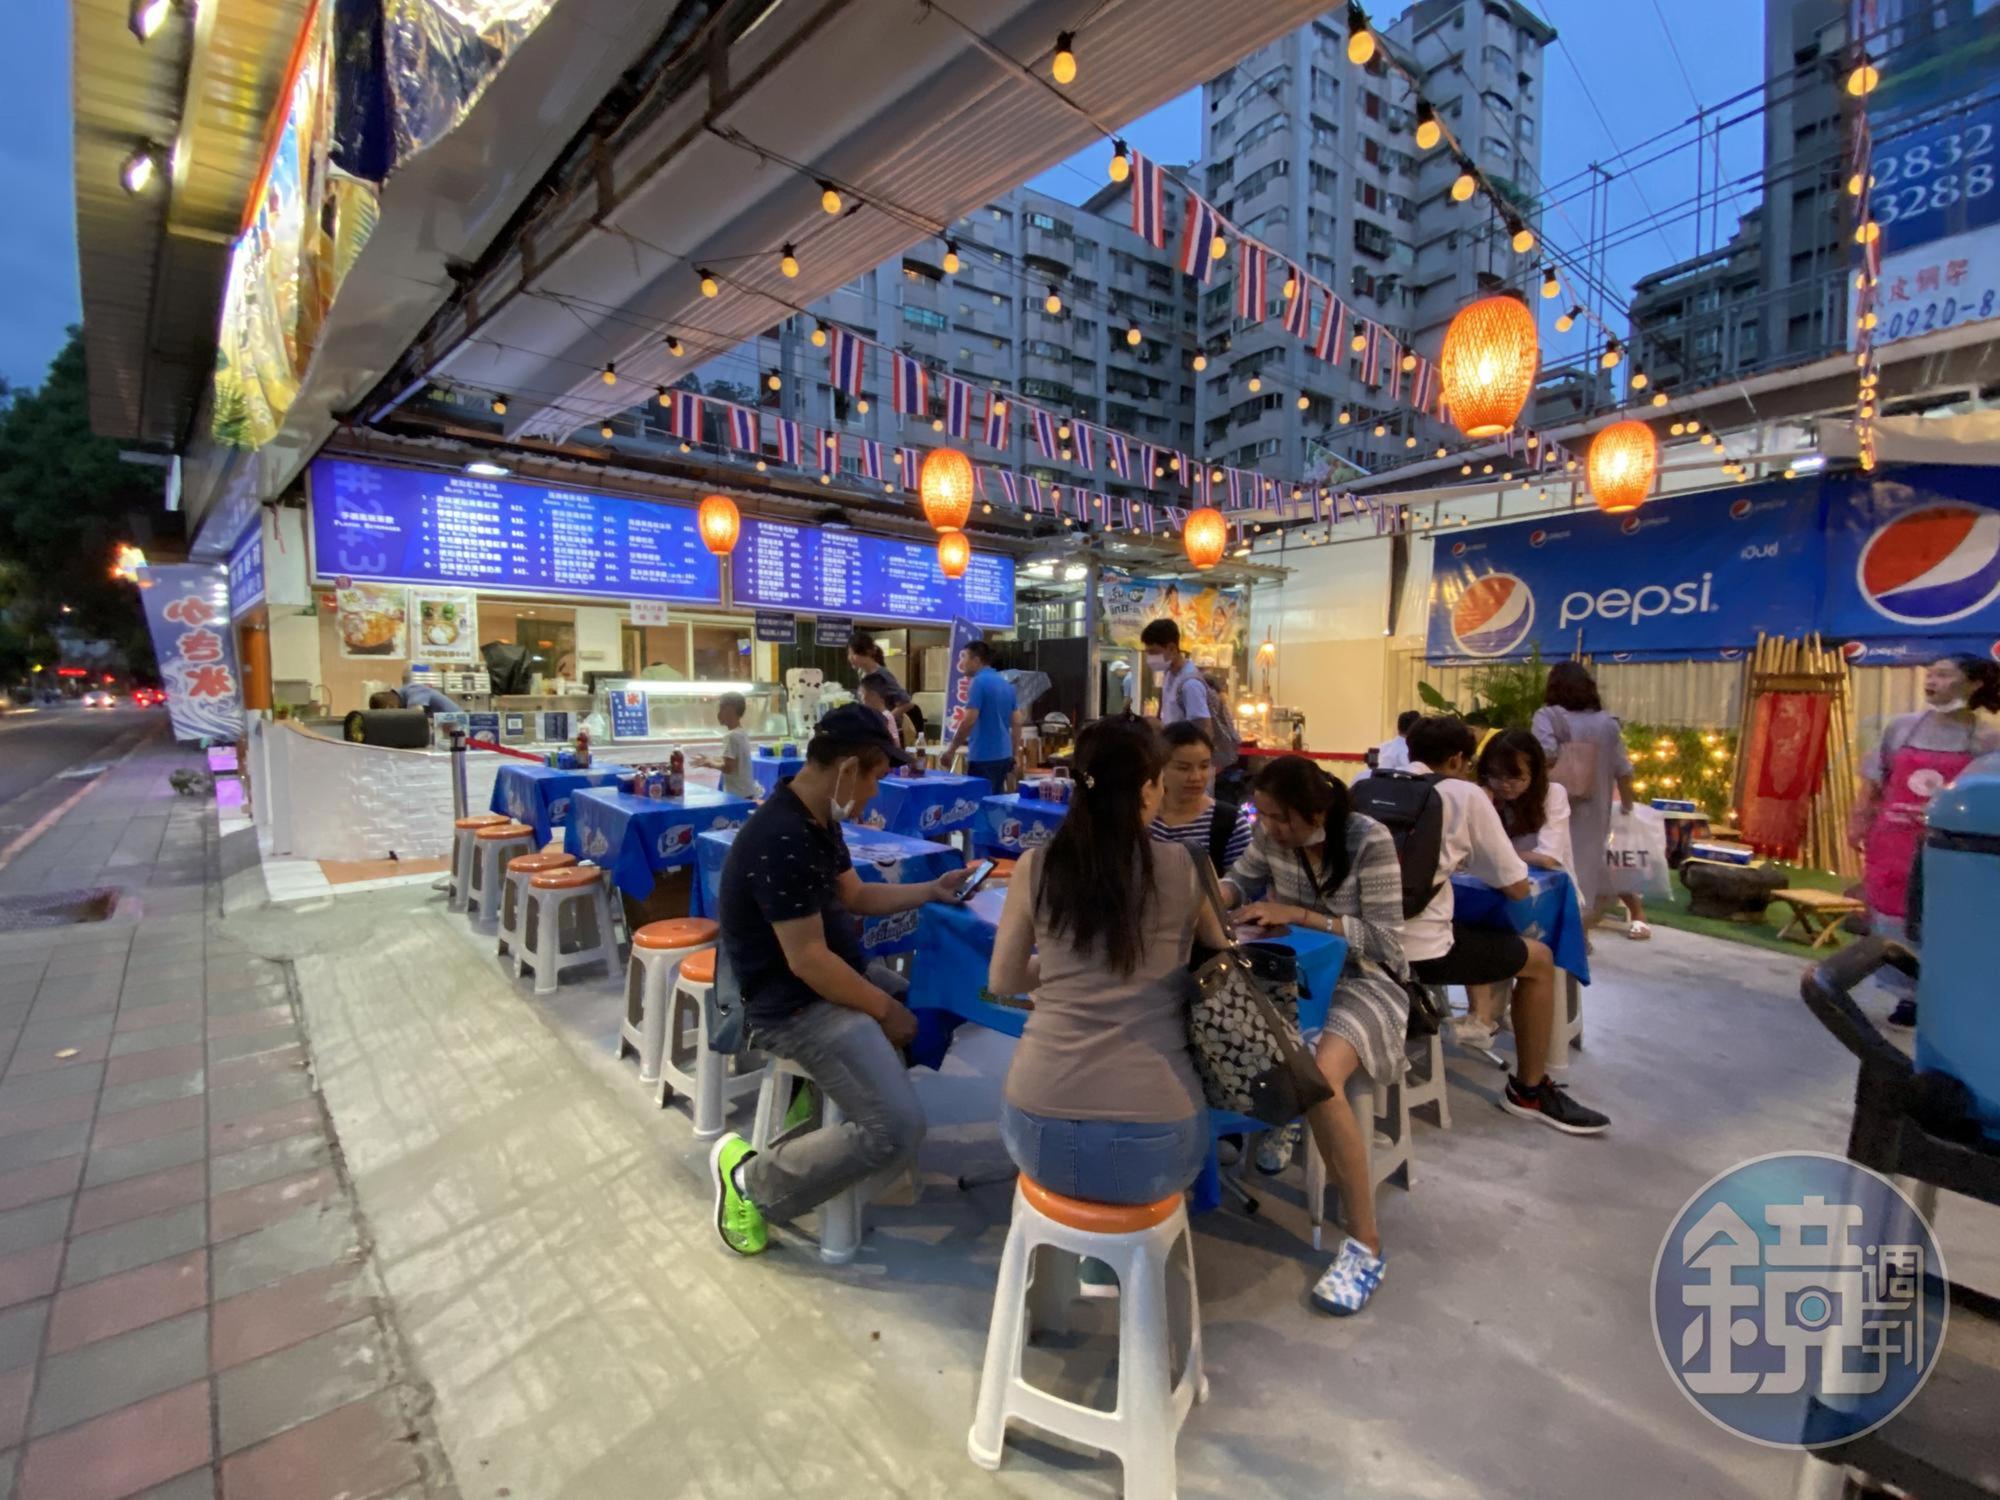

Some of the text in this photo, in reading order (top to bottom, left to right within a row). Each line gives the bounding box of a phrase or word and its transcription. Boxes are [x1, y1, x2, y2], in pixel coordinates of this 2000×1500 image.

[1873, 124, 1994, 190] 2832
[1876, 164, 1994, 227] 3288
[1559, 572, 1714, 630] pepsi
[1606, 850, 1650, 868] NET
